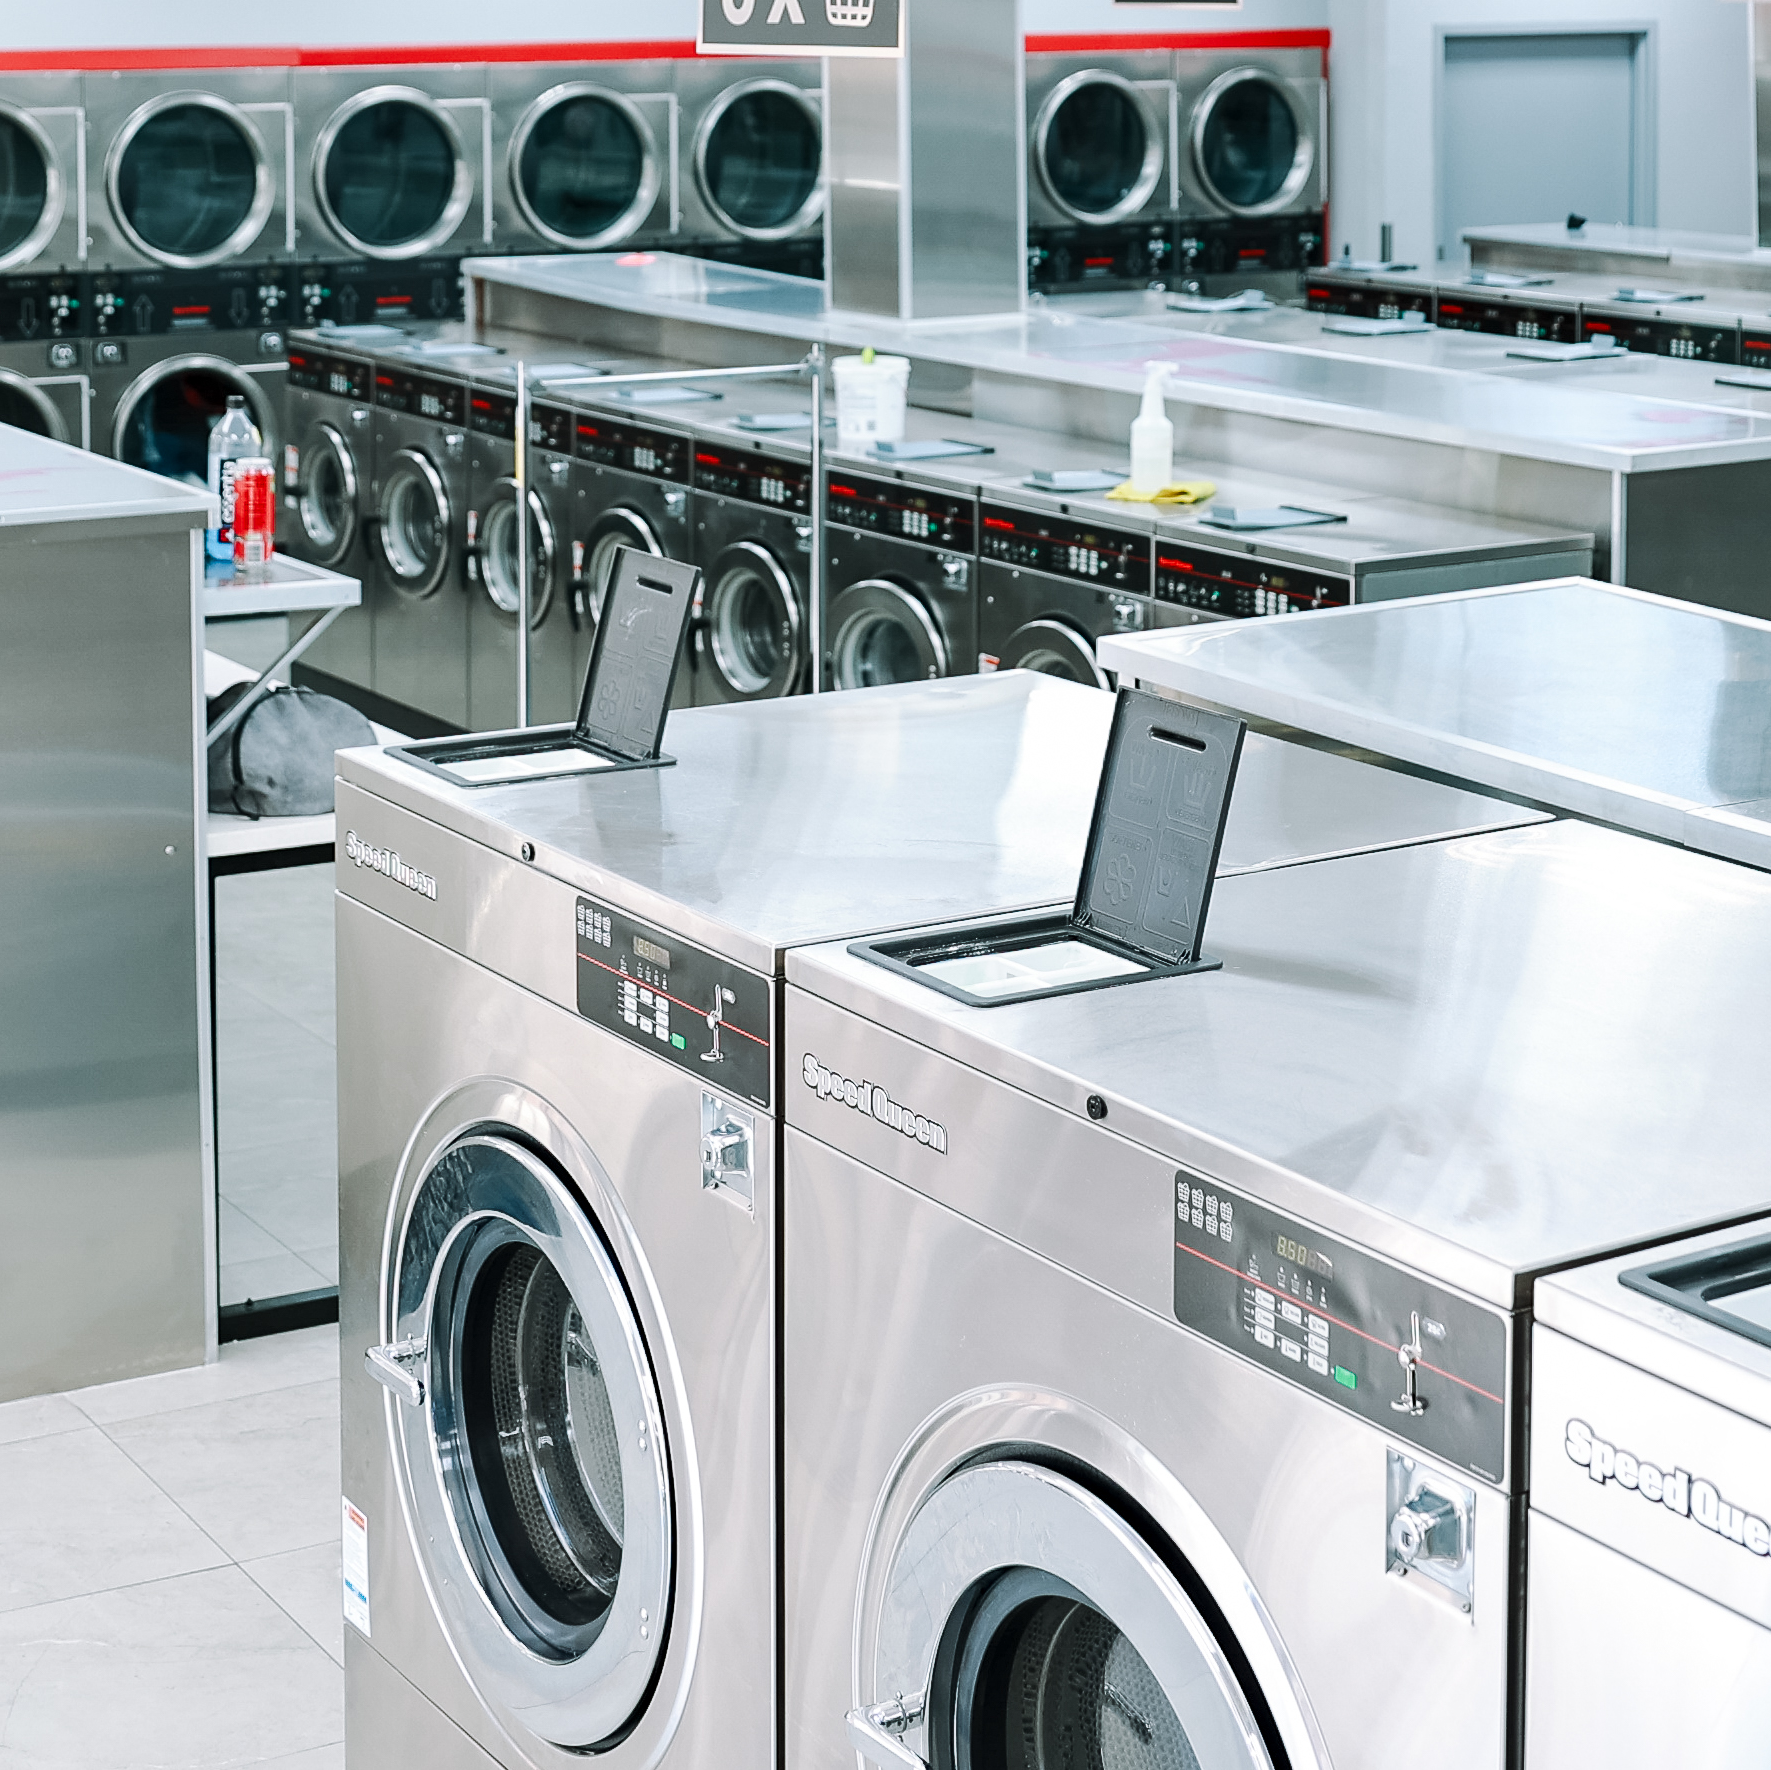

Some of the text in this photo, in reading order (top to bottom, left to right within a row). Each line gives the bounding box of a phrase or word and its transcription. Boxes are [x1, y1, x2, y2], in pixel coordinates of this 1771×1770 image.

[345, 830, 391, 878] Speed
[802, 1052, 948, 1156] Speed Queen
[1564, 1417, 1693, 1520] Speed
